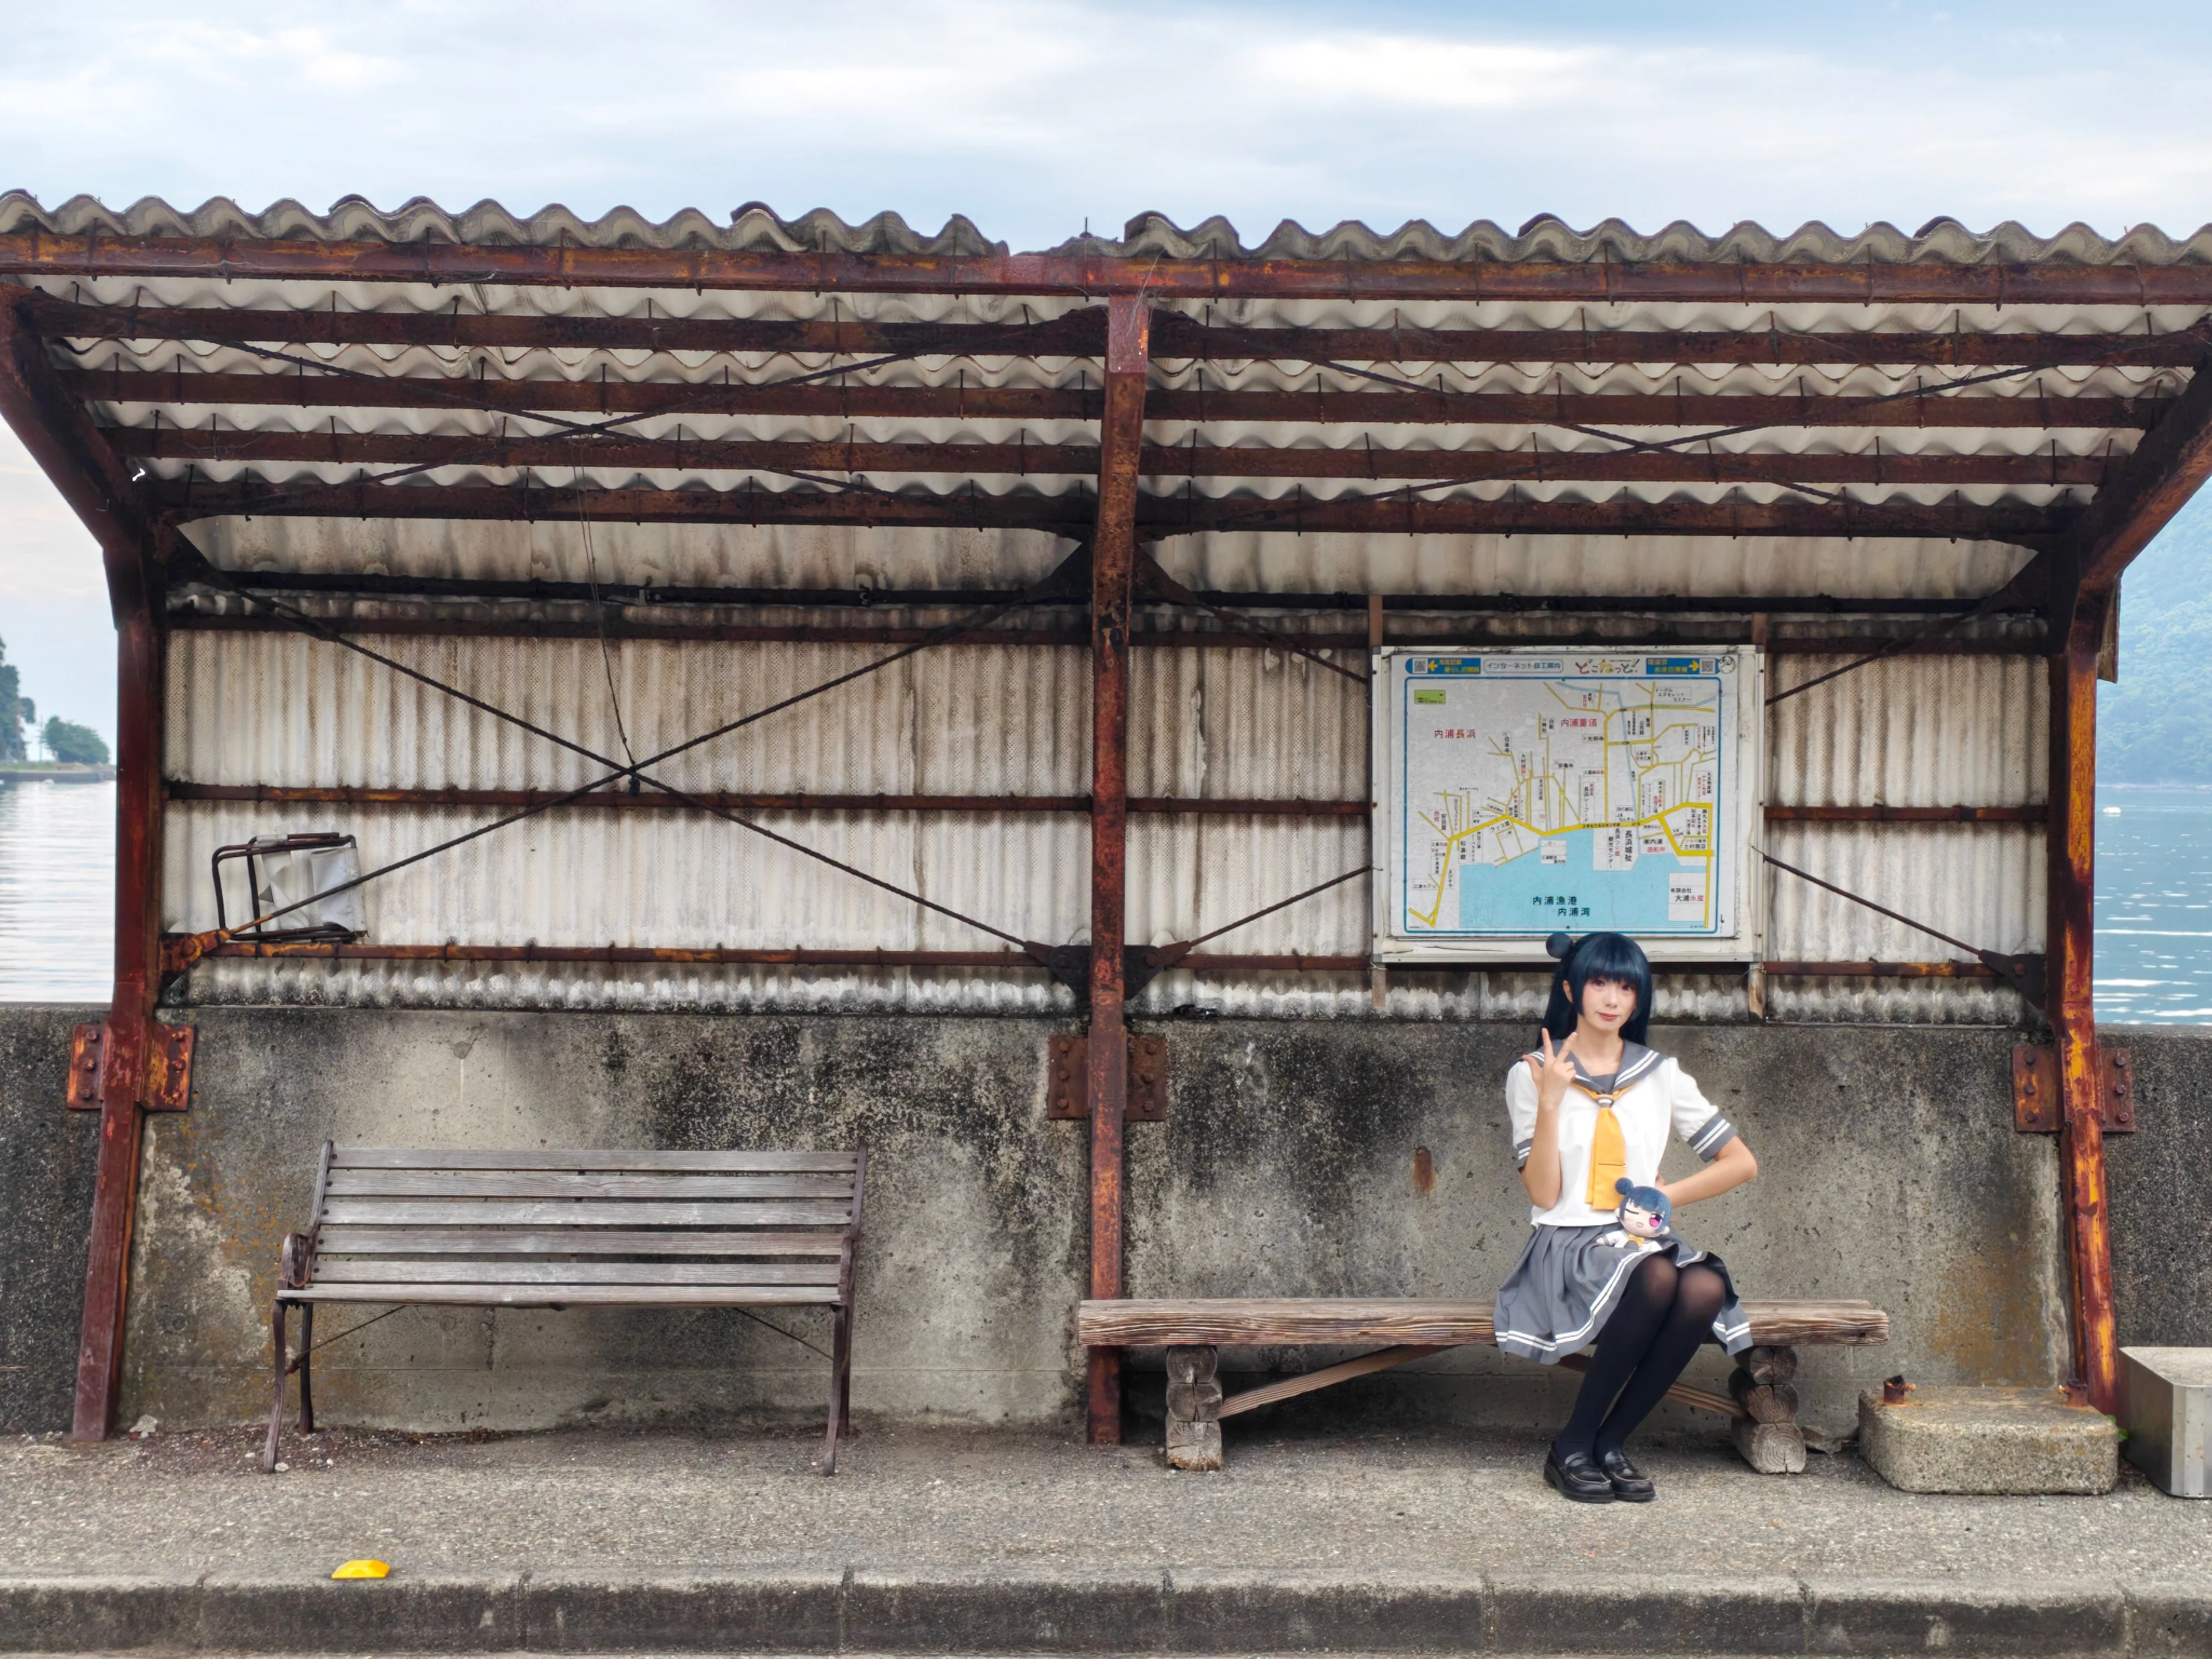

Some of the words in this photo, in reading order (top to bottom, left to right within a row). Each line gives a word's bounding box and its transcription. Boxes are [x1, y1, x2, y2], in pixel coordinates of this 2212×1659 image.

[1434, 729, 1476, 739] 内浦長浜
[1533, 895, 1577, 905] 内浦漁港
[1557, 907, 1590, 917] 内浦湾
